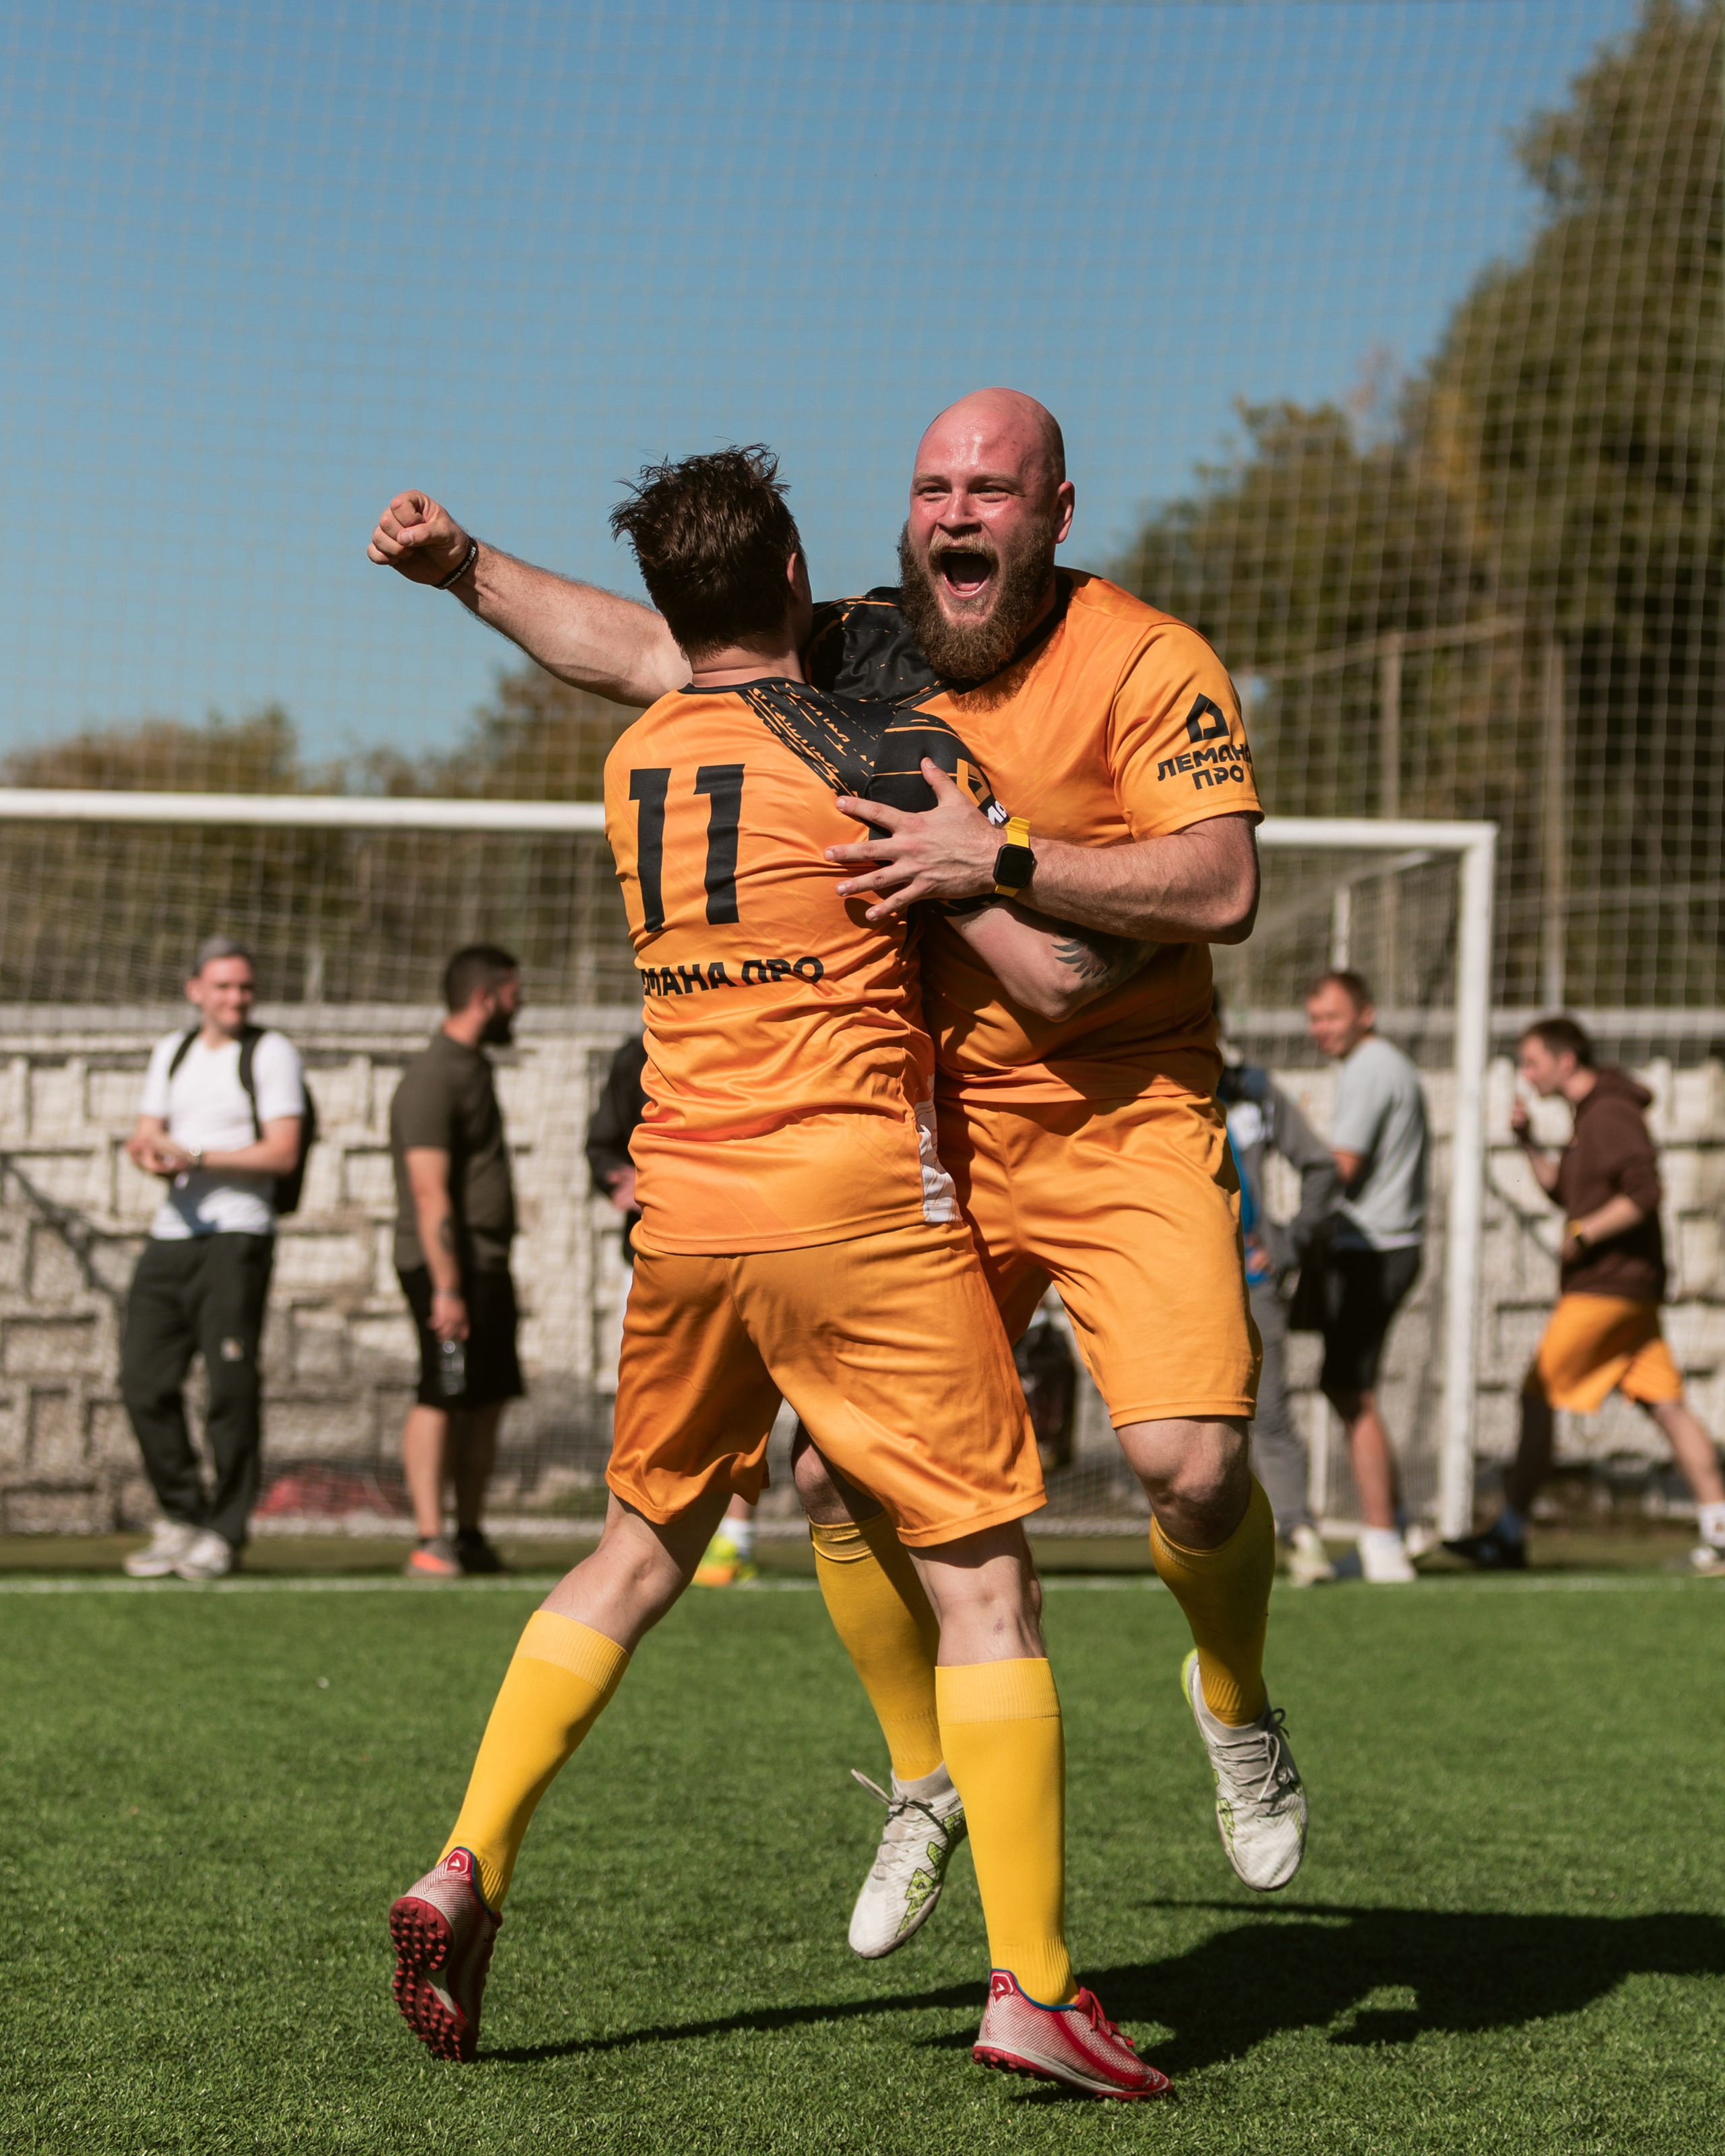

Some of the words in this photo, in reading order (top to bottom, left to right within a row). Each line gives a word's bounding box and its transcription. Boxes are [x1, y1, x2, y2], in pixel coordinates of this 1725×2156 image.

[460, 561, 470, 573] ПРО
[1157, 743, 1253, 782] ЛЕМАНА
[1191, 764, 1245, 791] ПРО
[629, 763, 746, 934] 11
[641, 961, 738, 996] МАНА
[741, 955, 824, 986] ПРО
